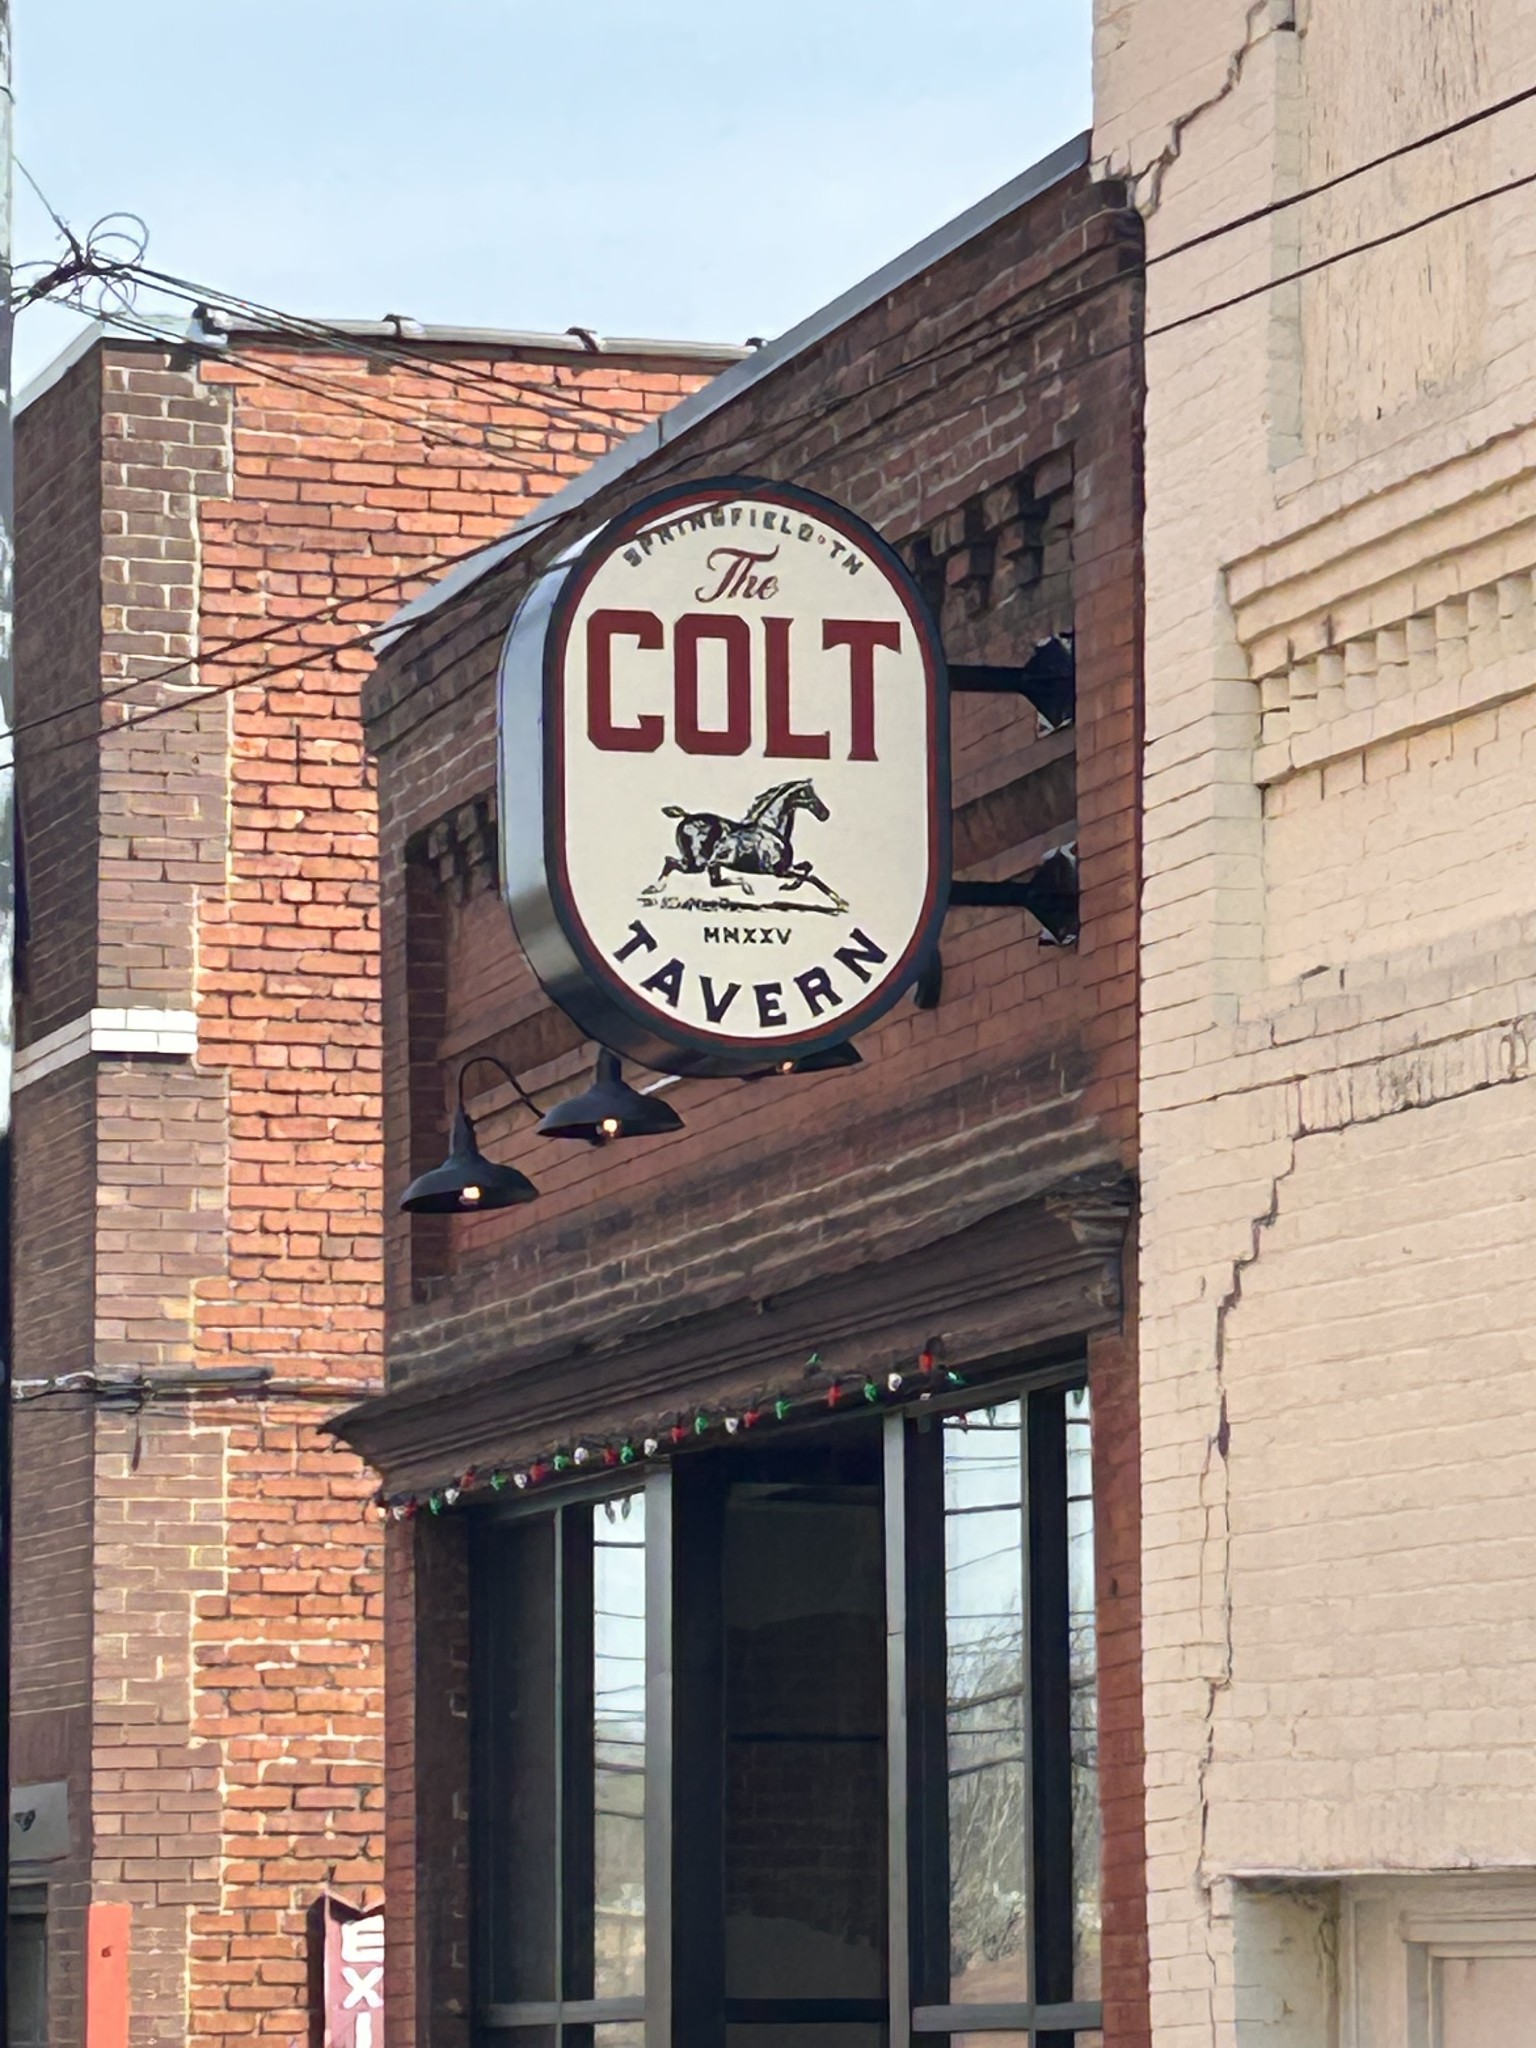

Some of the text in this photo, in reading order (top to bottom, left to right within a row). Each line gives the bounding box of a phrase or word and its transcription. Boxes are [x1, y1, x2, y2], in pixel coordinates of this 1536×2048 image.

[695, 544, 780, 603] The
[586, 608, 902, 762] COLT
[612, 919, 888, 1028] TAVERN
